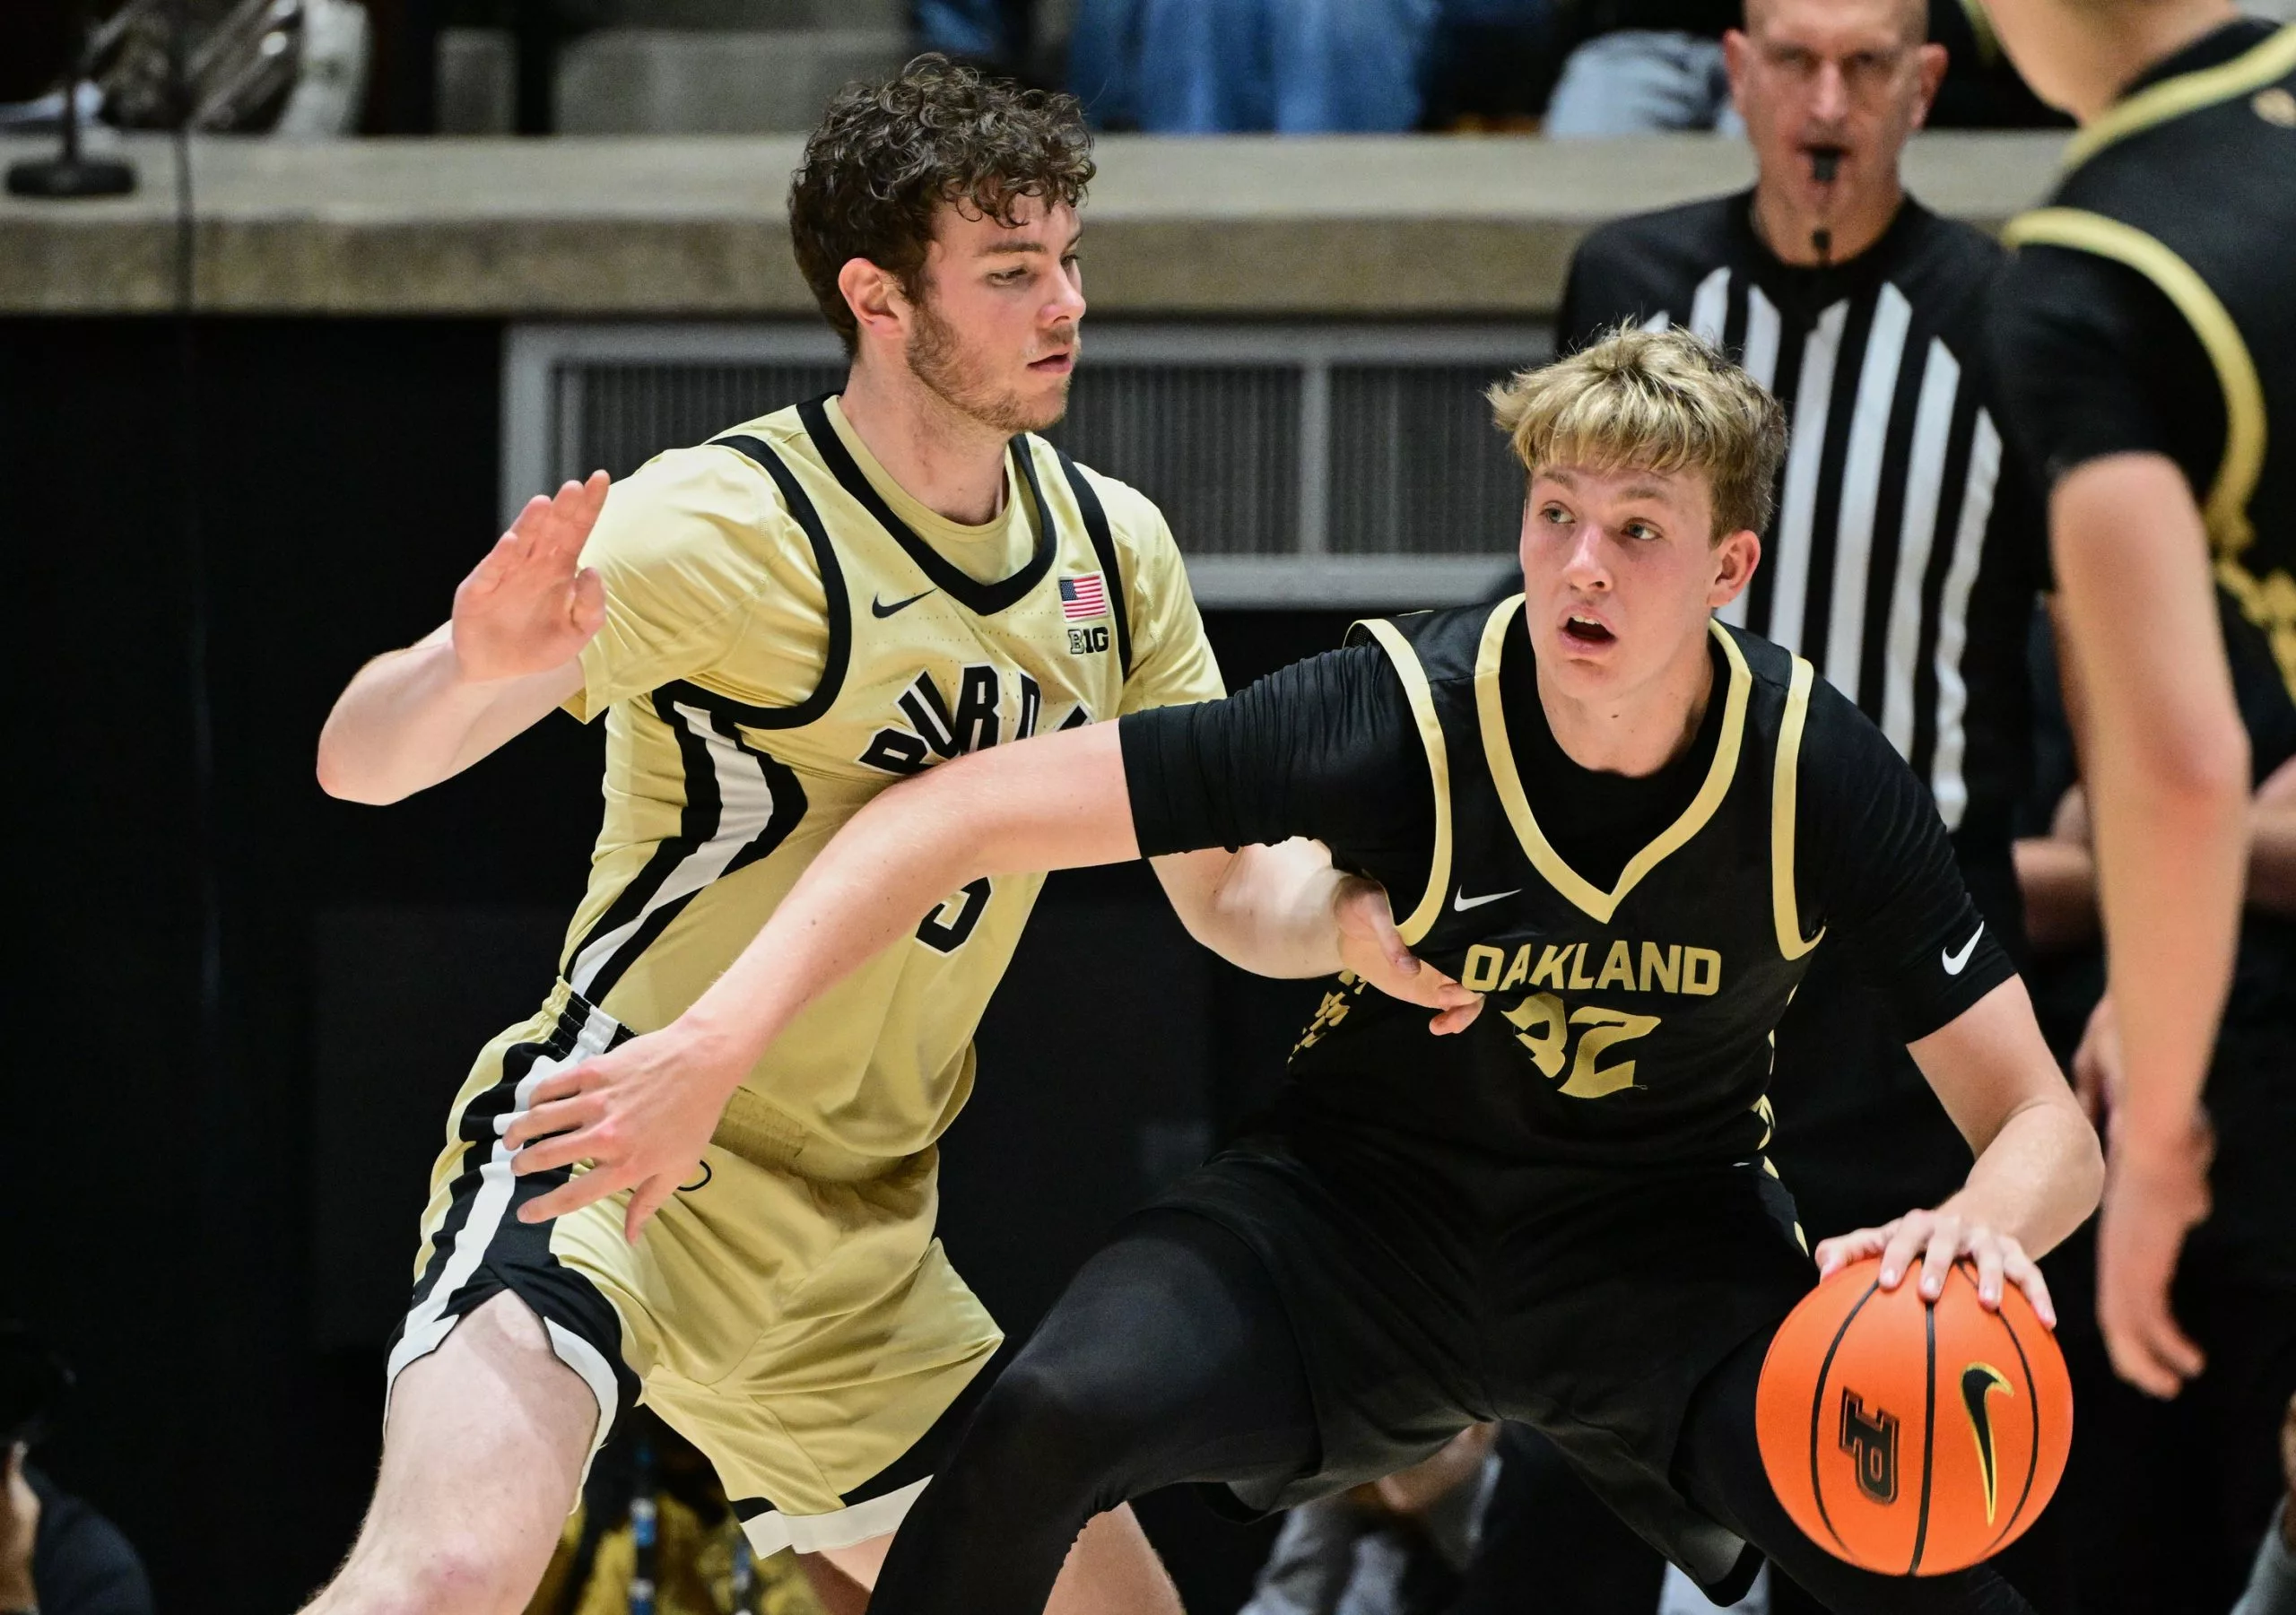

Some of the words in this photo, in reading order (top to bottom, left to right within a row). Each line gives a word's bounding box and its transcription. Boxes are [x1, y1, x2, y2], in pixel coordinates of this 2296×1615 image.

[857, 662, 1093, 777] PURD
[1461, 940, 1722, 996] OAKLAND
[1839, 1386, 1900, 1506] P
